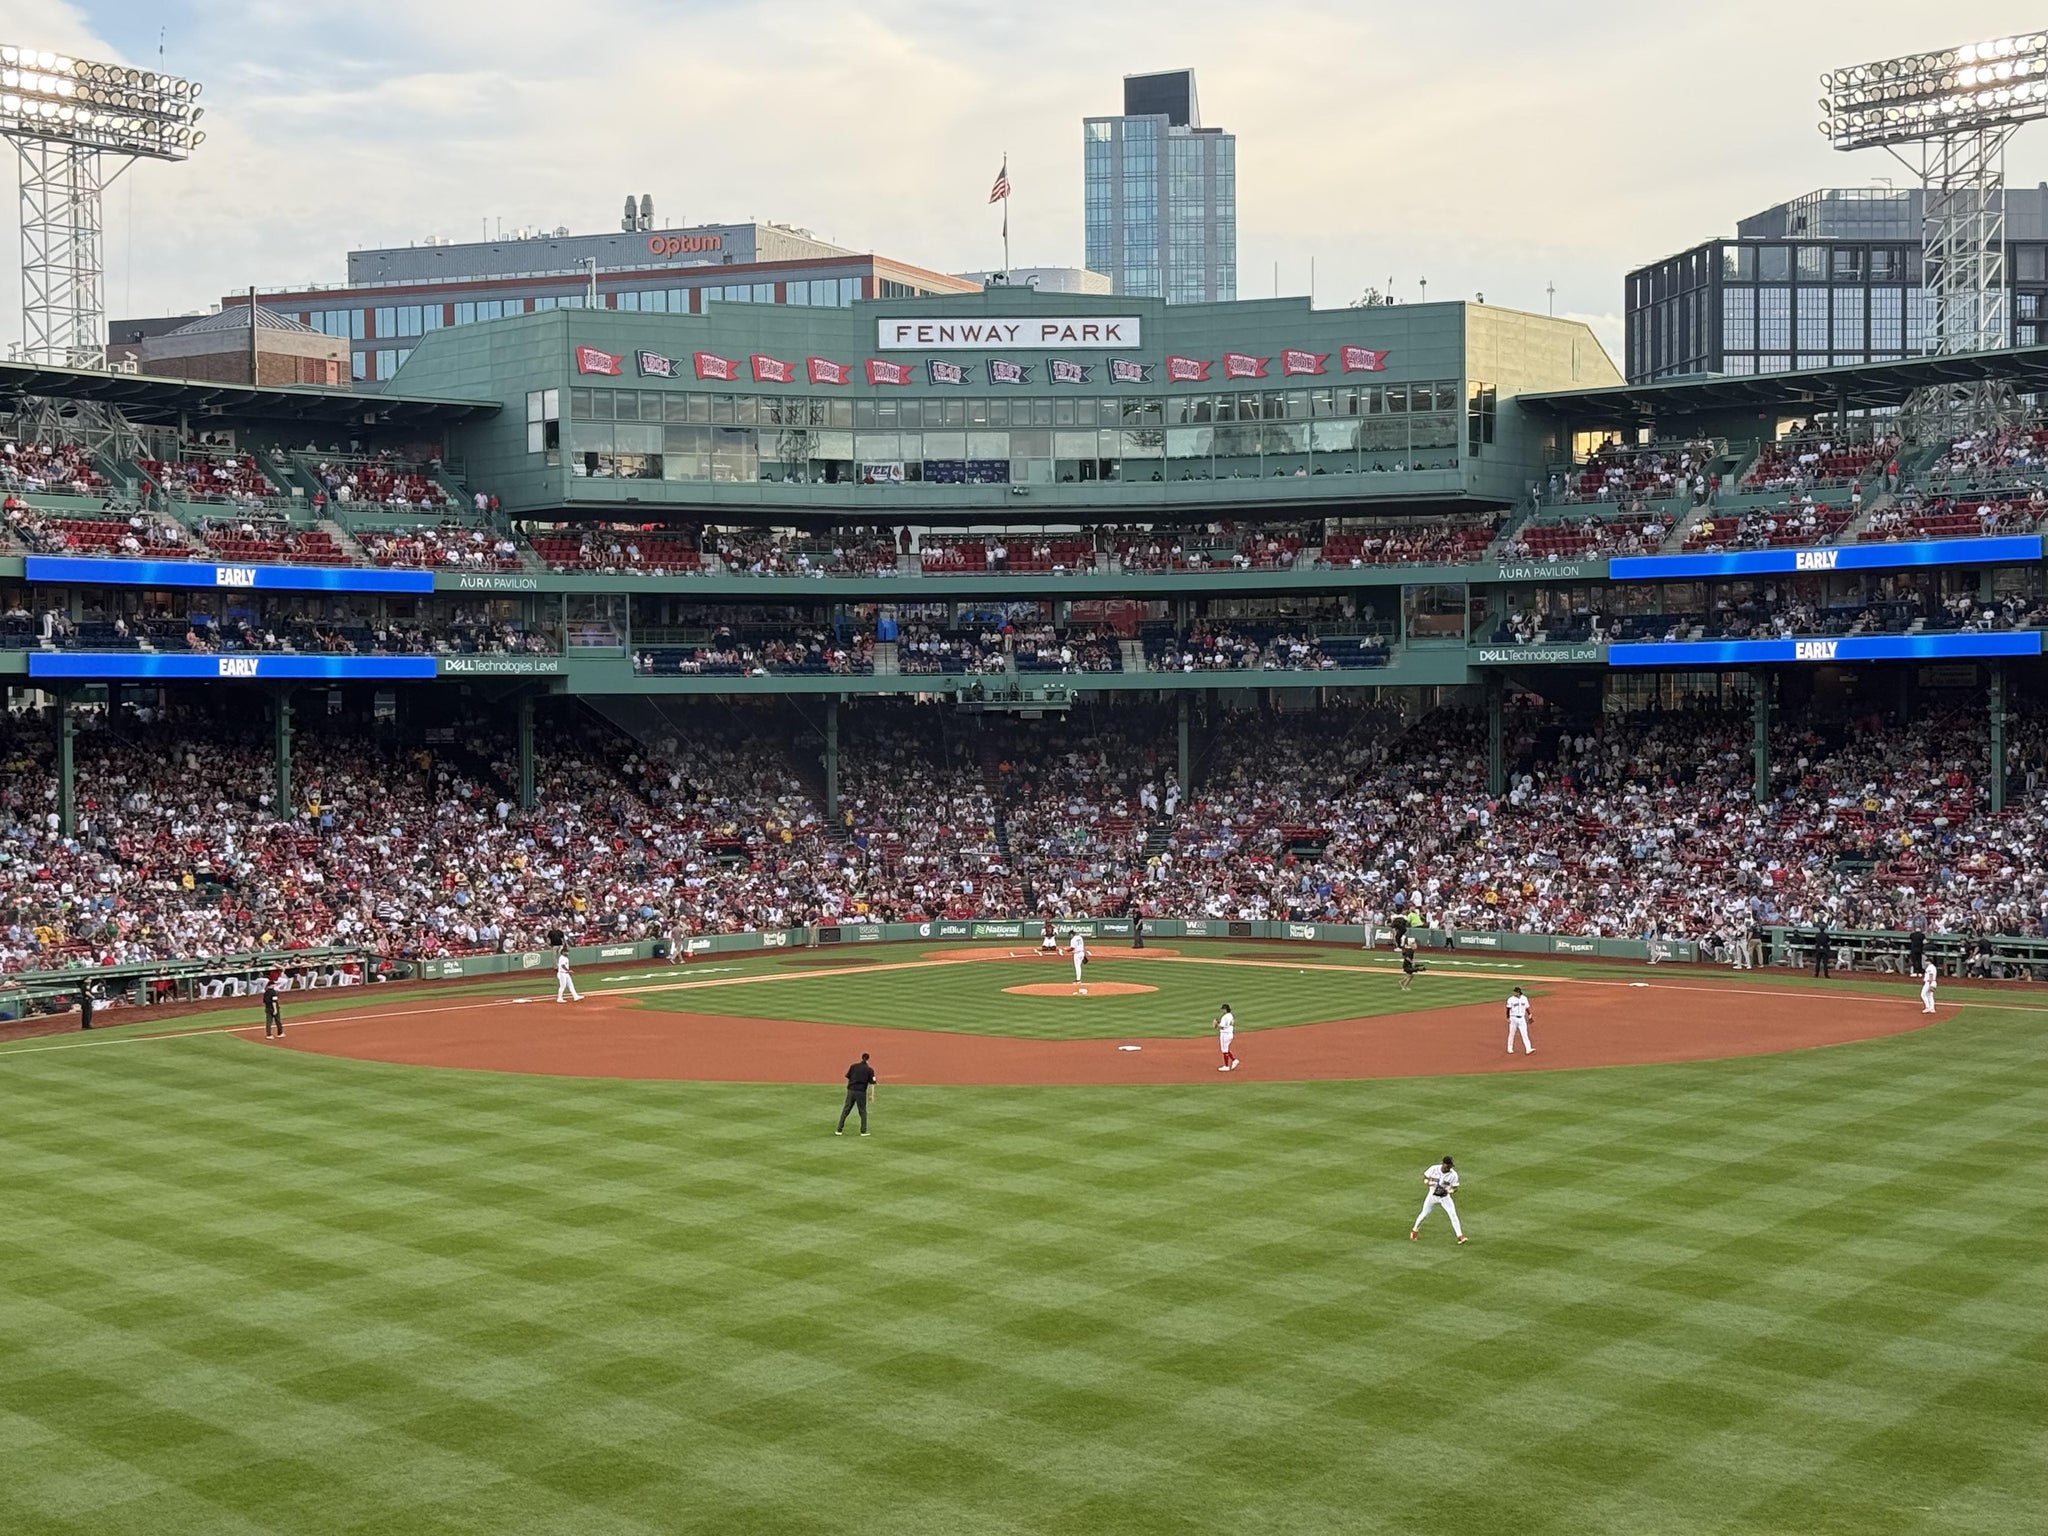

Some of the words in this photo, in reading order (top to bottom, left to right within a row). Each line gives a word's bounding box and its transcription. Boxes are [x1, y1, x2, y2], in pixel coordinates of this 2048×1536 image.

[648, 234, 721, 259] Optum
[896, 325, 1020, 342] FENWAY
[1041, 324, 1122, 341] PARK
[1795, 551, 1839, 570] EARLY
[216, 567, 257, 586] EARLY
[1533, 566, 1579, 578] PAVILION
[494, 578, 537, 589] PAVILION
[1571, 647, 1597, 660] Level
[1795, 641, 1839, 660] EARLY
[219, 658, 259, 676] EARLY
[534, 660, 558, 671] Level
[940, 925, 966, 936] jetBlue
[985, 924, 1020, 934] National
[1059, 924, 1093, 934] National
[1570, 944, 1594, 952] TICKET
